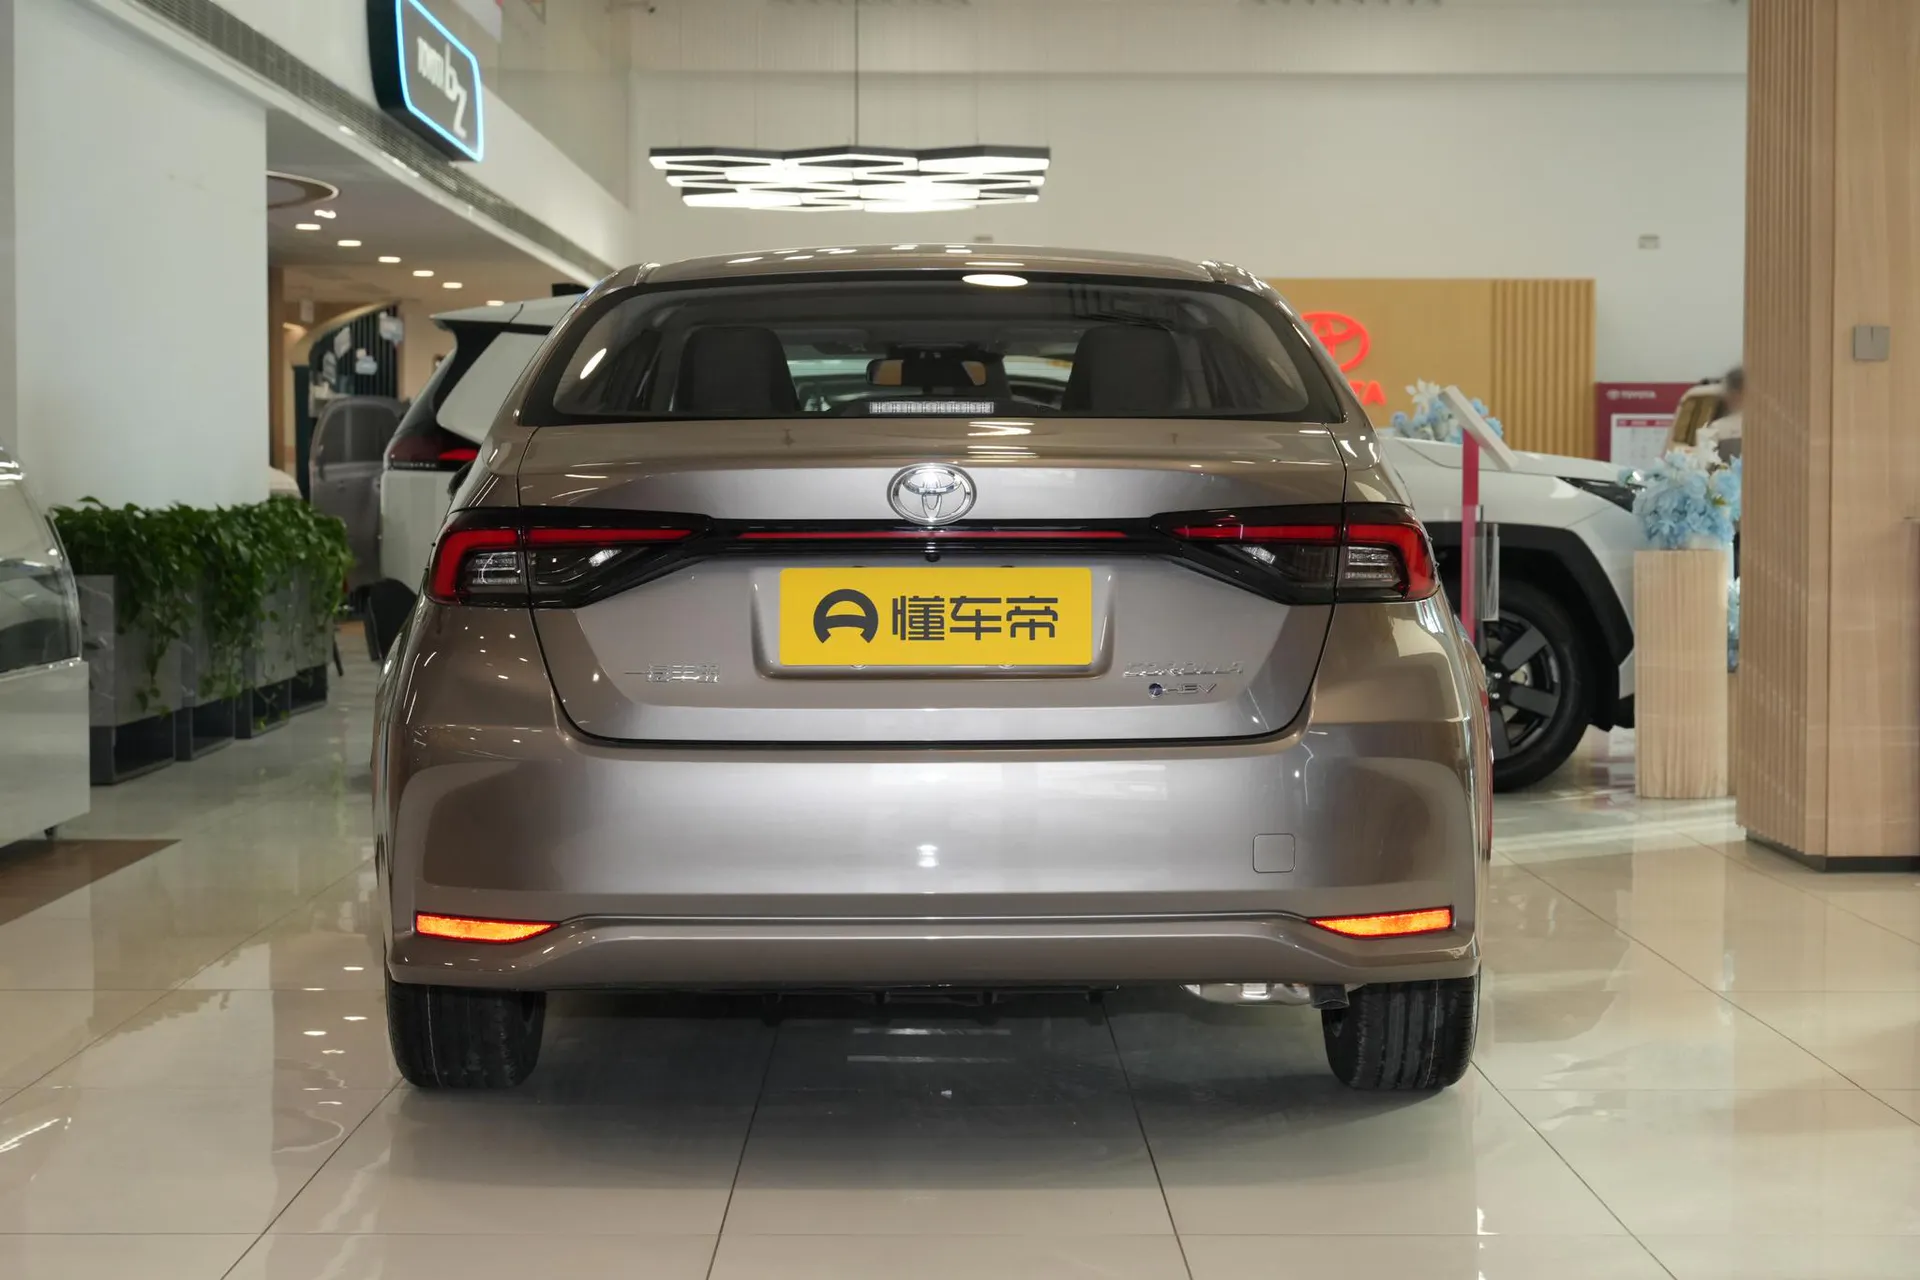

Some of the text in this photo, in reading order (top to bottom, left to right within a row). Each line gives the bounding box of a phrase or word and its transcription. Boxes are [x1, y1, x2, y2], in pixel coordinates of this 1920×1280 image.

[892, 595, 1058, 641] 懂车帝
[1123, 661, 1244, 677] COROLLA
